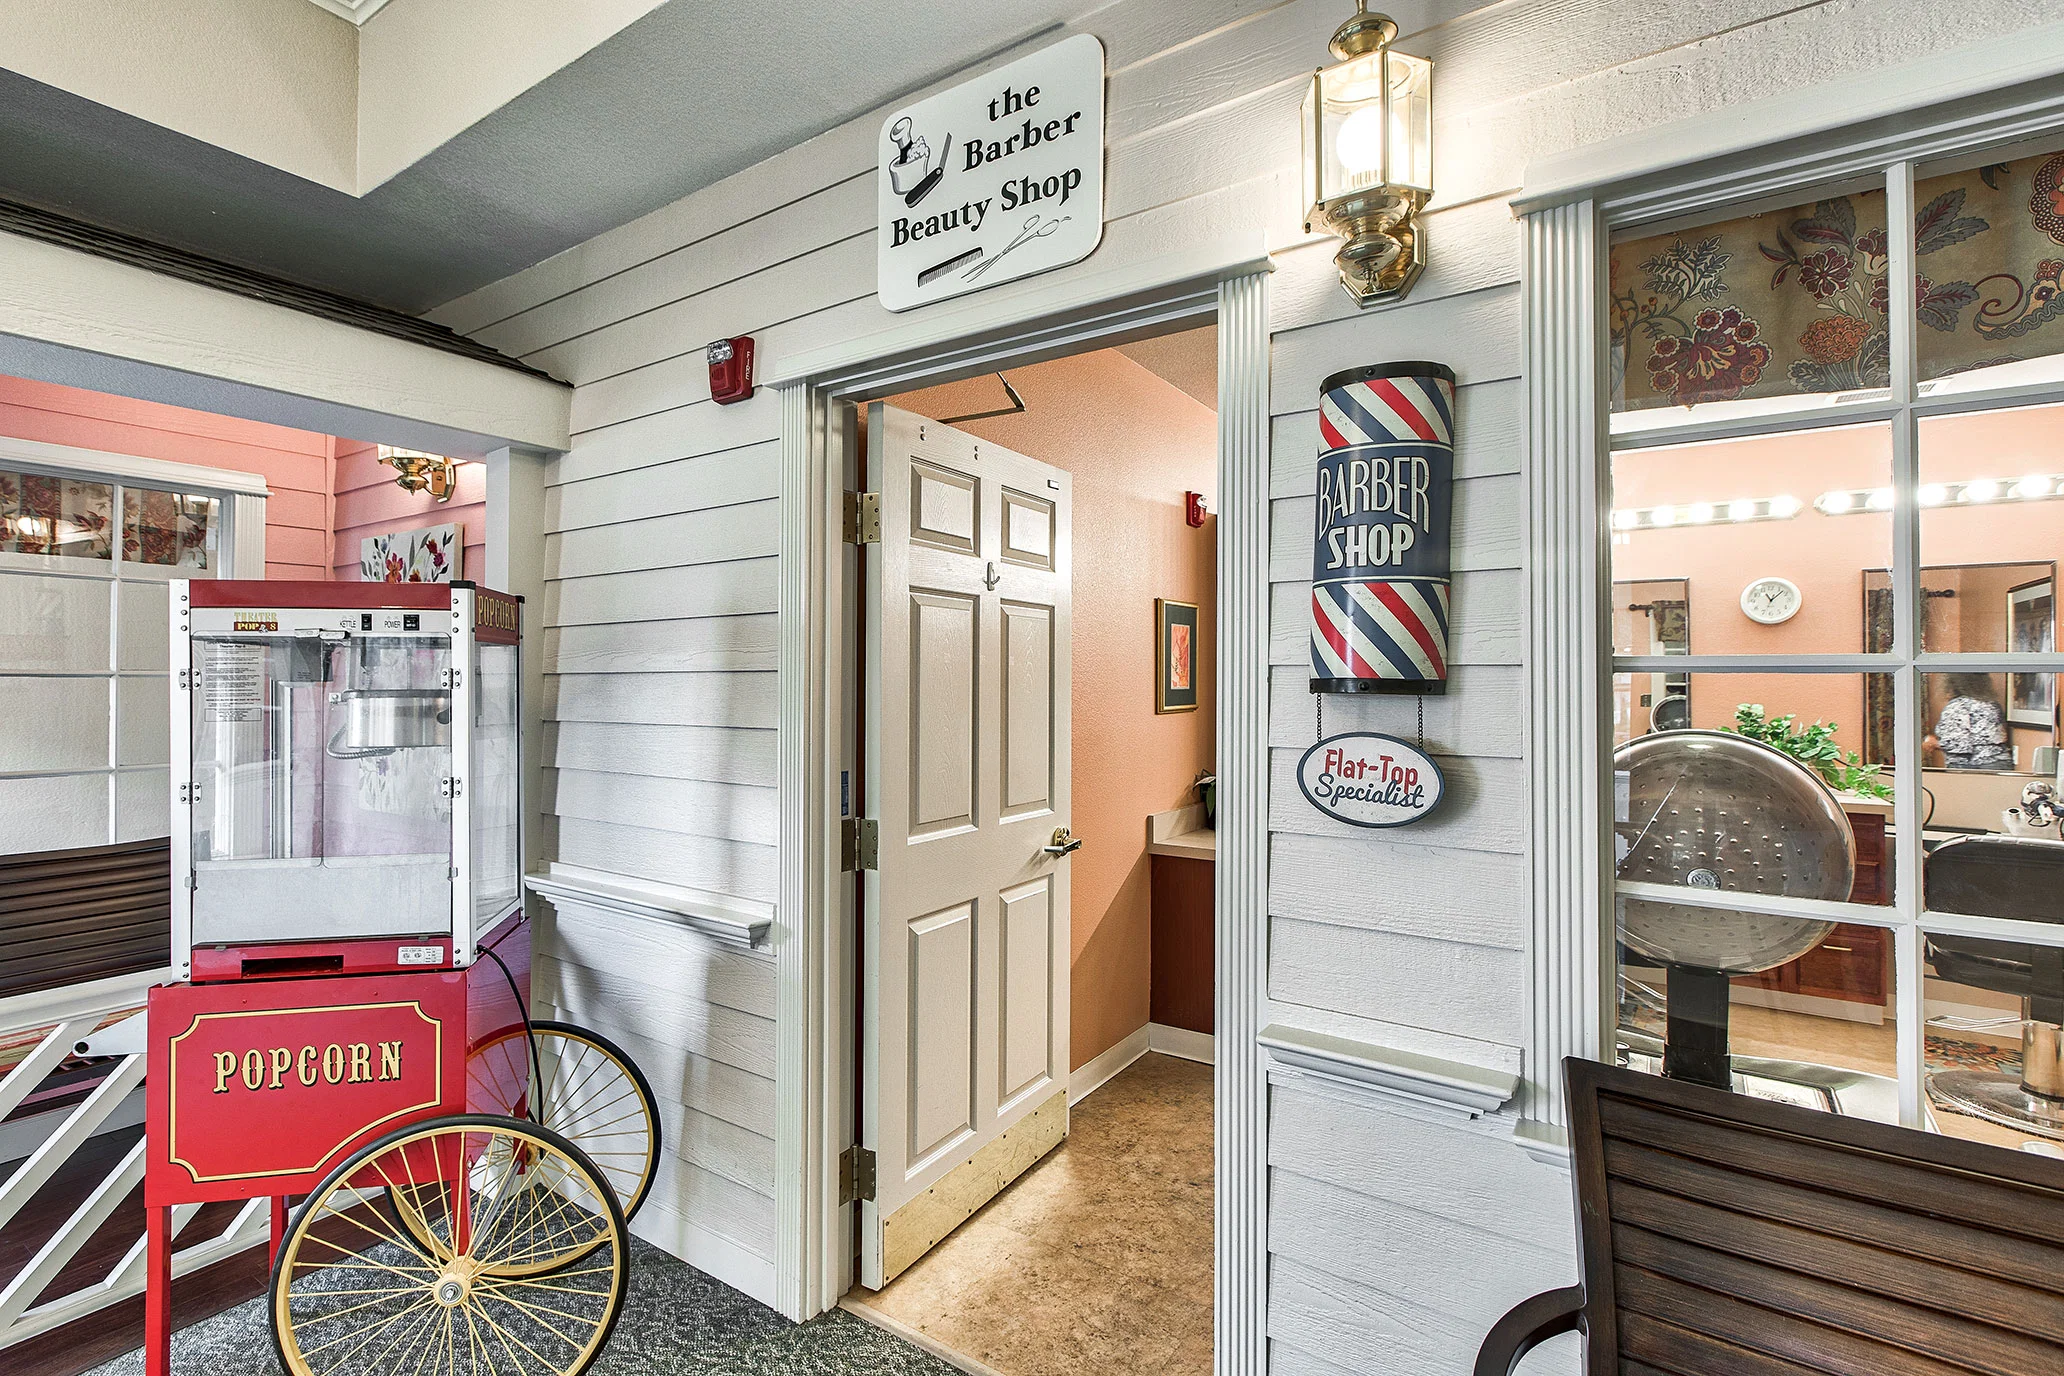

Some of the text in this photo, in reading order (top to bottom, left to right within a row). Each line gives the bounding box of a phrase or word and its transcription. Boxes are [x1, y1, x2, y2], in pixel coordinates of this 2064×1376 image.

[986, 85, 1041, 122] the
[962, 111, 1082, 173] Barber
[890, 167, 1082, 248] Beauty Shop
[1318, 456, 1431, 541] BARBER
[1326, 523, 1416, 570] SHOP
[234, 611, 278, 622] THEATER
[237, 623, 276, 631] POP 8
[384, 620, 401, 628] POWER
[477, 595, 516, 631] POPCORN
[1314, 772, 1425, 809] Specialist
[1324, 747, 1419, 794] Flat-Top
[212, 1040, 404, 1094] POPCORN
